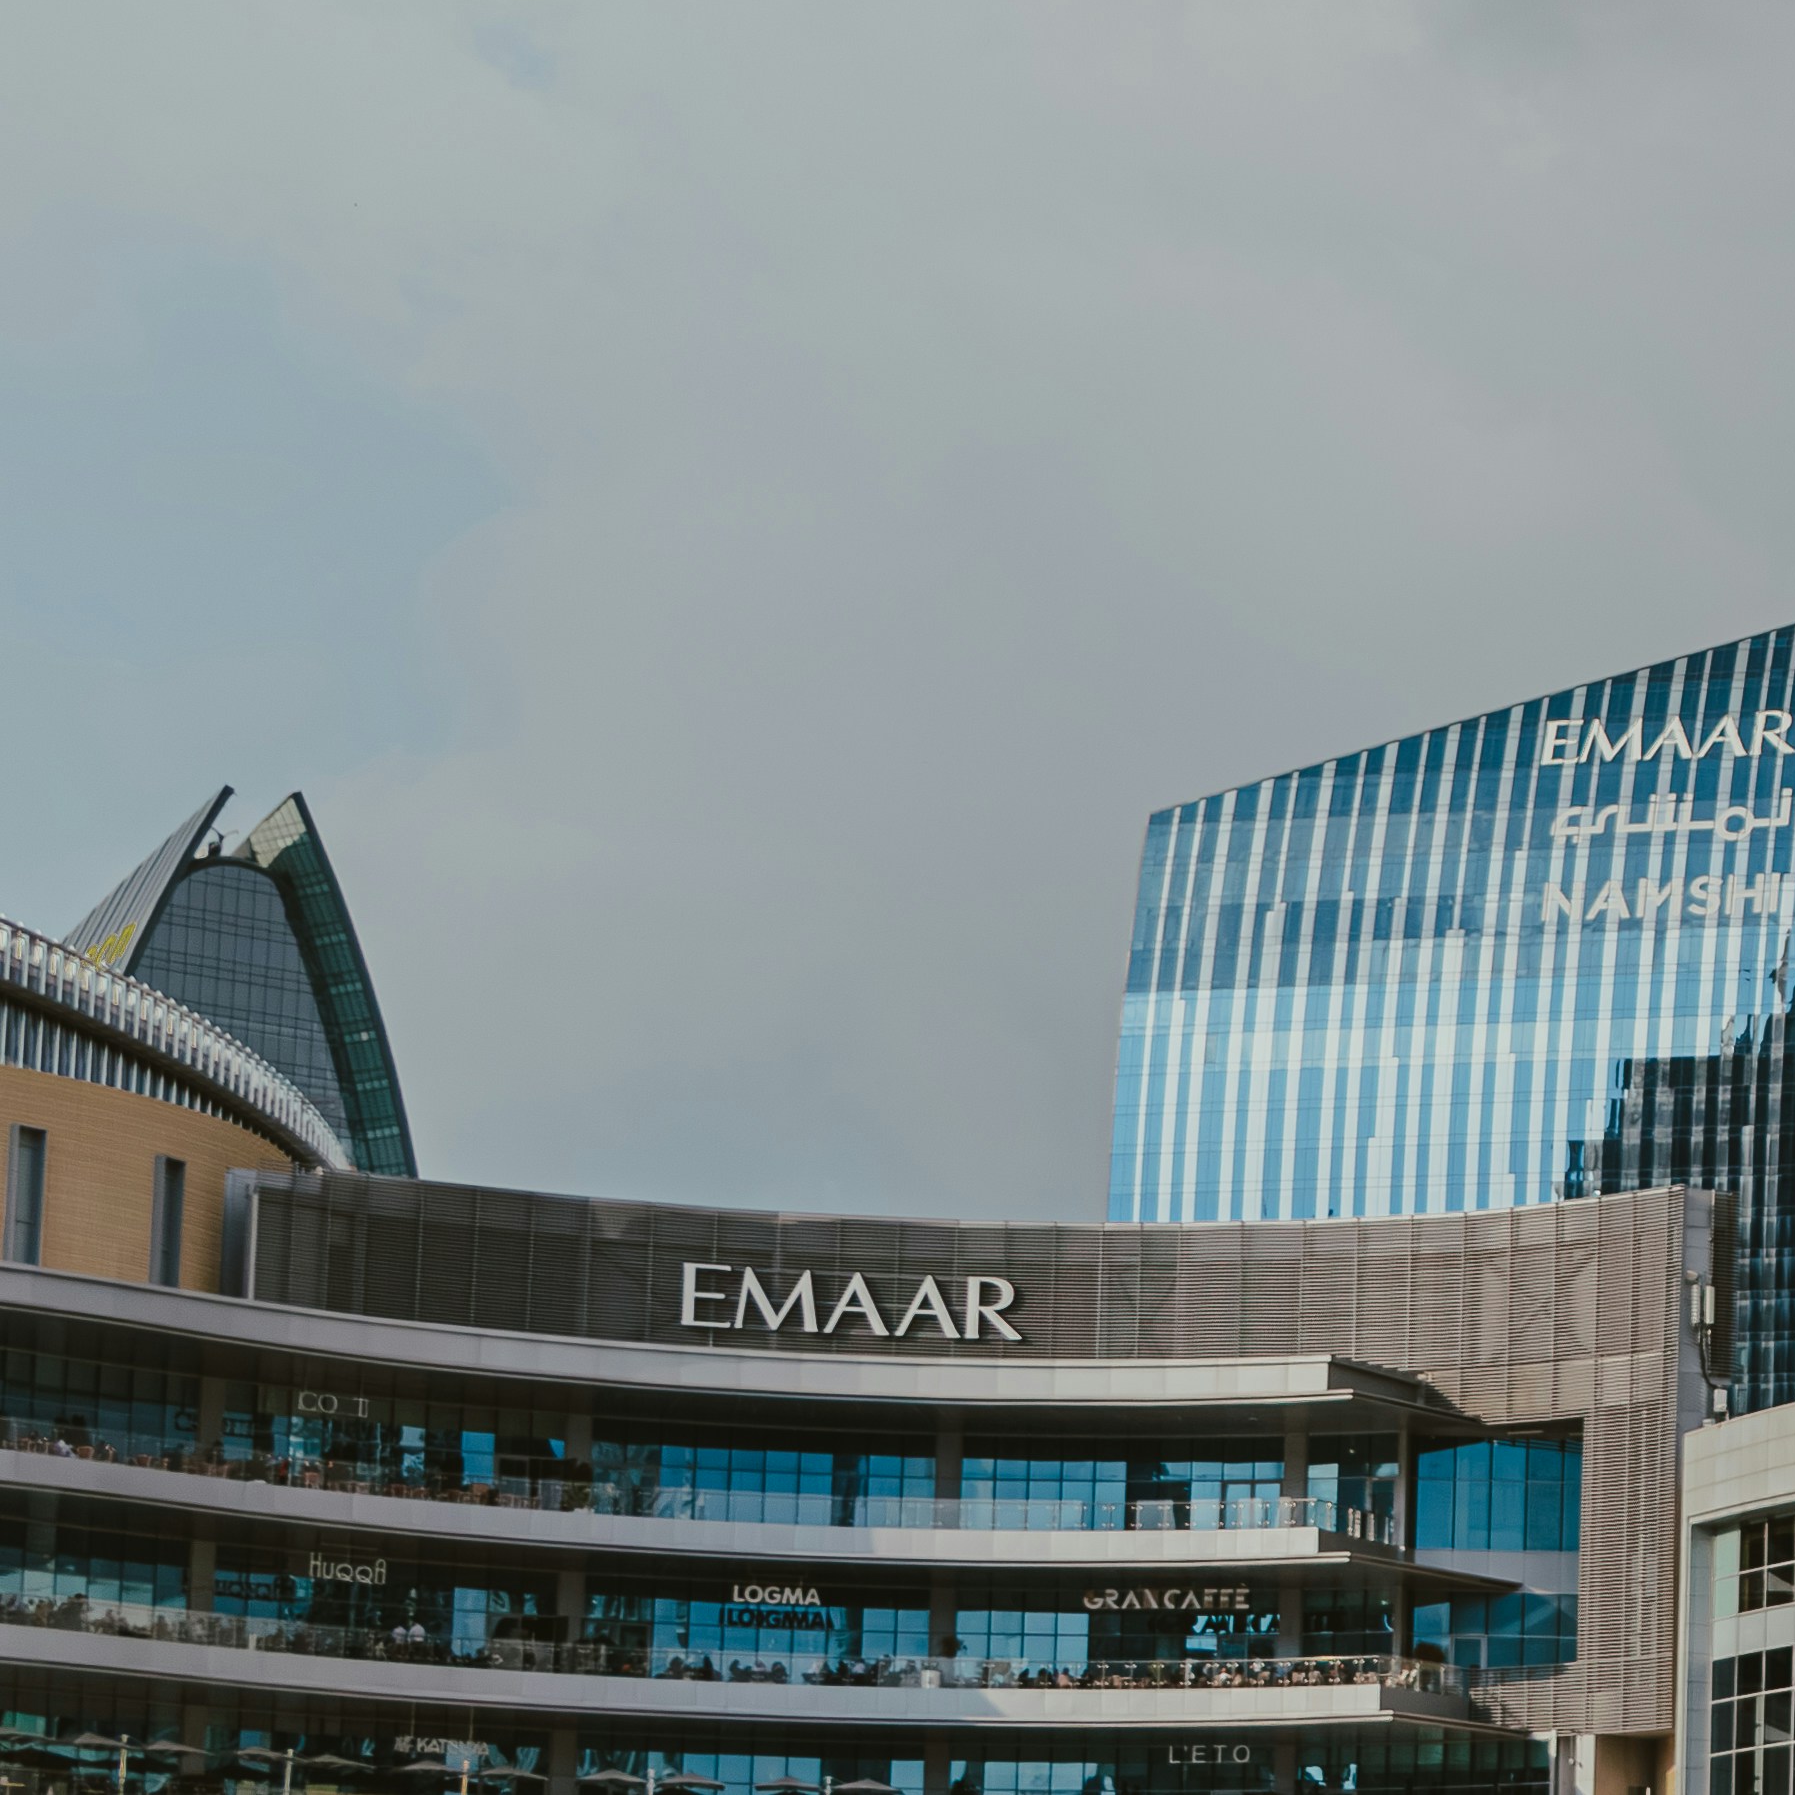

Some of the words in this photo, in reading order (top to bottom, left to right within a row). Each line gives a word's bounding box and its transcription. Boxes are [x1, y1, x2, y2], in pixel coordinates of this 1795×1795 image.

[1540, 871, 1781, 922] NAMSHI
[680, 1261, 1023, 1341] EMAAR
[732, 1584, 821, 1606] LOGMA
[1168, 1744, 1251, 1764] L'ETO
